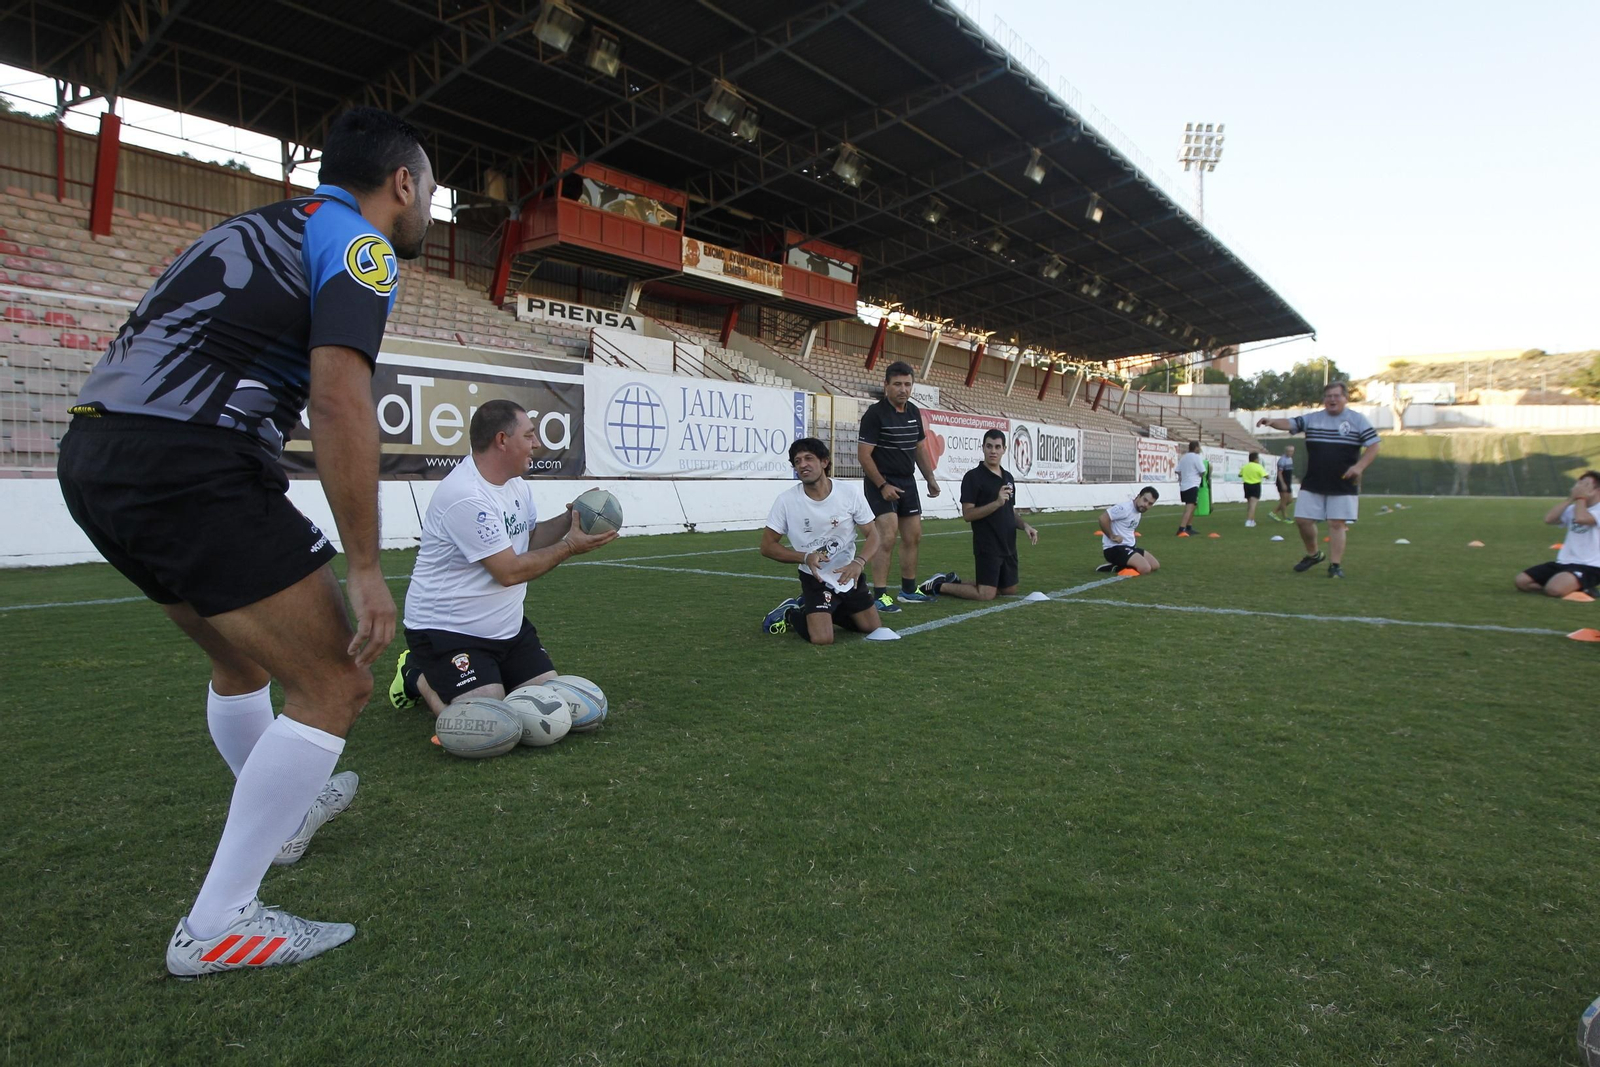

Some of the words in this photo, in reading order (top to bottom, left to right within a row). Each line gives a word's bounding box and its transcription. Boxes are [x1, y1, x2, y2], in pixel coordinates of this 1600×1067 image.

[729, 251, 771, 274] AYUNTAMIENTO
[773, 264, 781, 275] DE
[527, 297, 637, 331] PRENSA
[678, 386, 755, 423] JAIME
[795, 399, 804, 420] 401
[931, 413, 1007, 430] www.conectapymes.net
[678, 422, 788, 456] AVELINO
[947, 435, 982, 451] CONECTA
[1036, 427, 1076, 464] lamarca
[679, 458, 719, 471] BUFETE
[720, 459, 735, 471] DE
[736, 460, 788, 472] ABOGADOS
[1138, 453, 1168, 473] RESPETO
[460, 669, 475, 679] CLAN
[436, 717, 498, 733] GILBERT
[272, 923, 324, 967] ESSI
